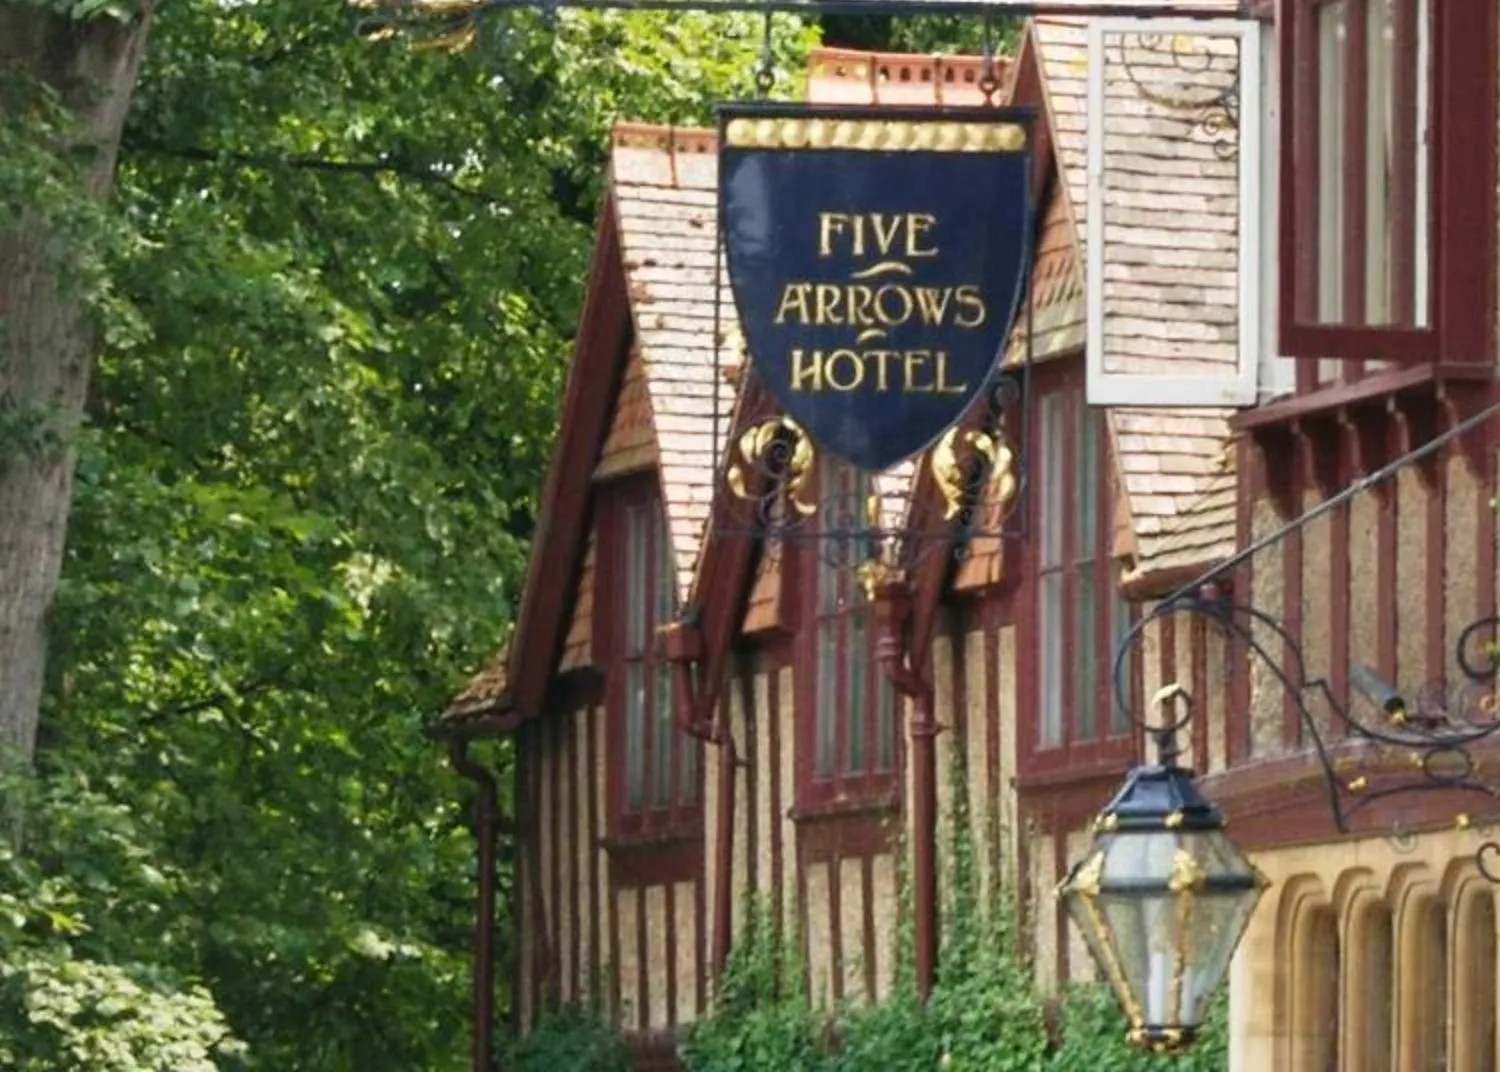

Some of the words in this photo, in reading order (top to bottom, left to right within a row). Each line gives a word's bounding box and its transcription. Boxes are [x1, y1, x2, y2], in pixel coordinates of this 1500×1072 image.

[818, 212, 939, 256] FIVE
[773, 283, 986, 327] ARROWS
[789, 349, 968, 393] HOTEL
